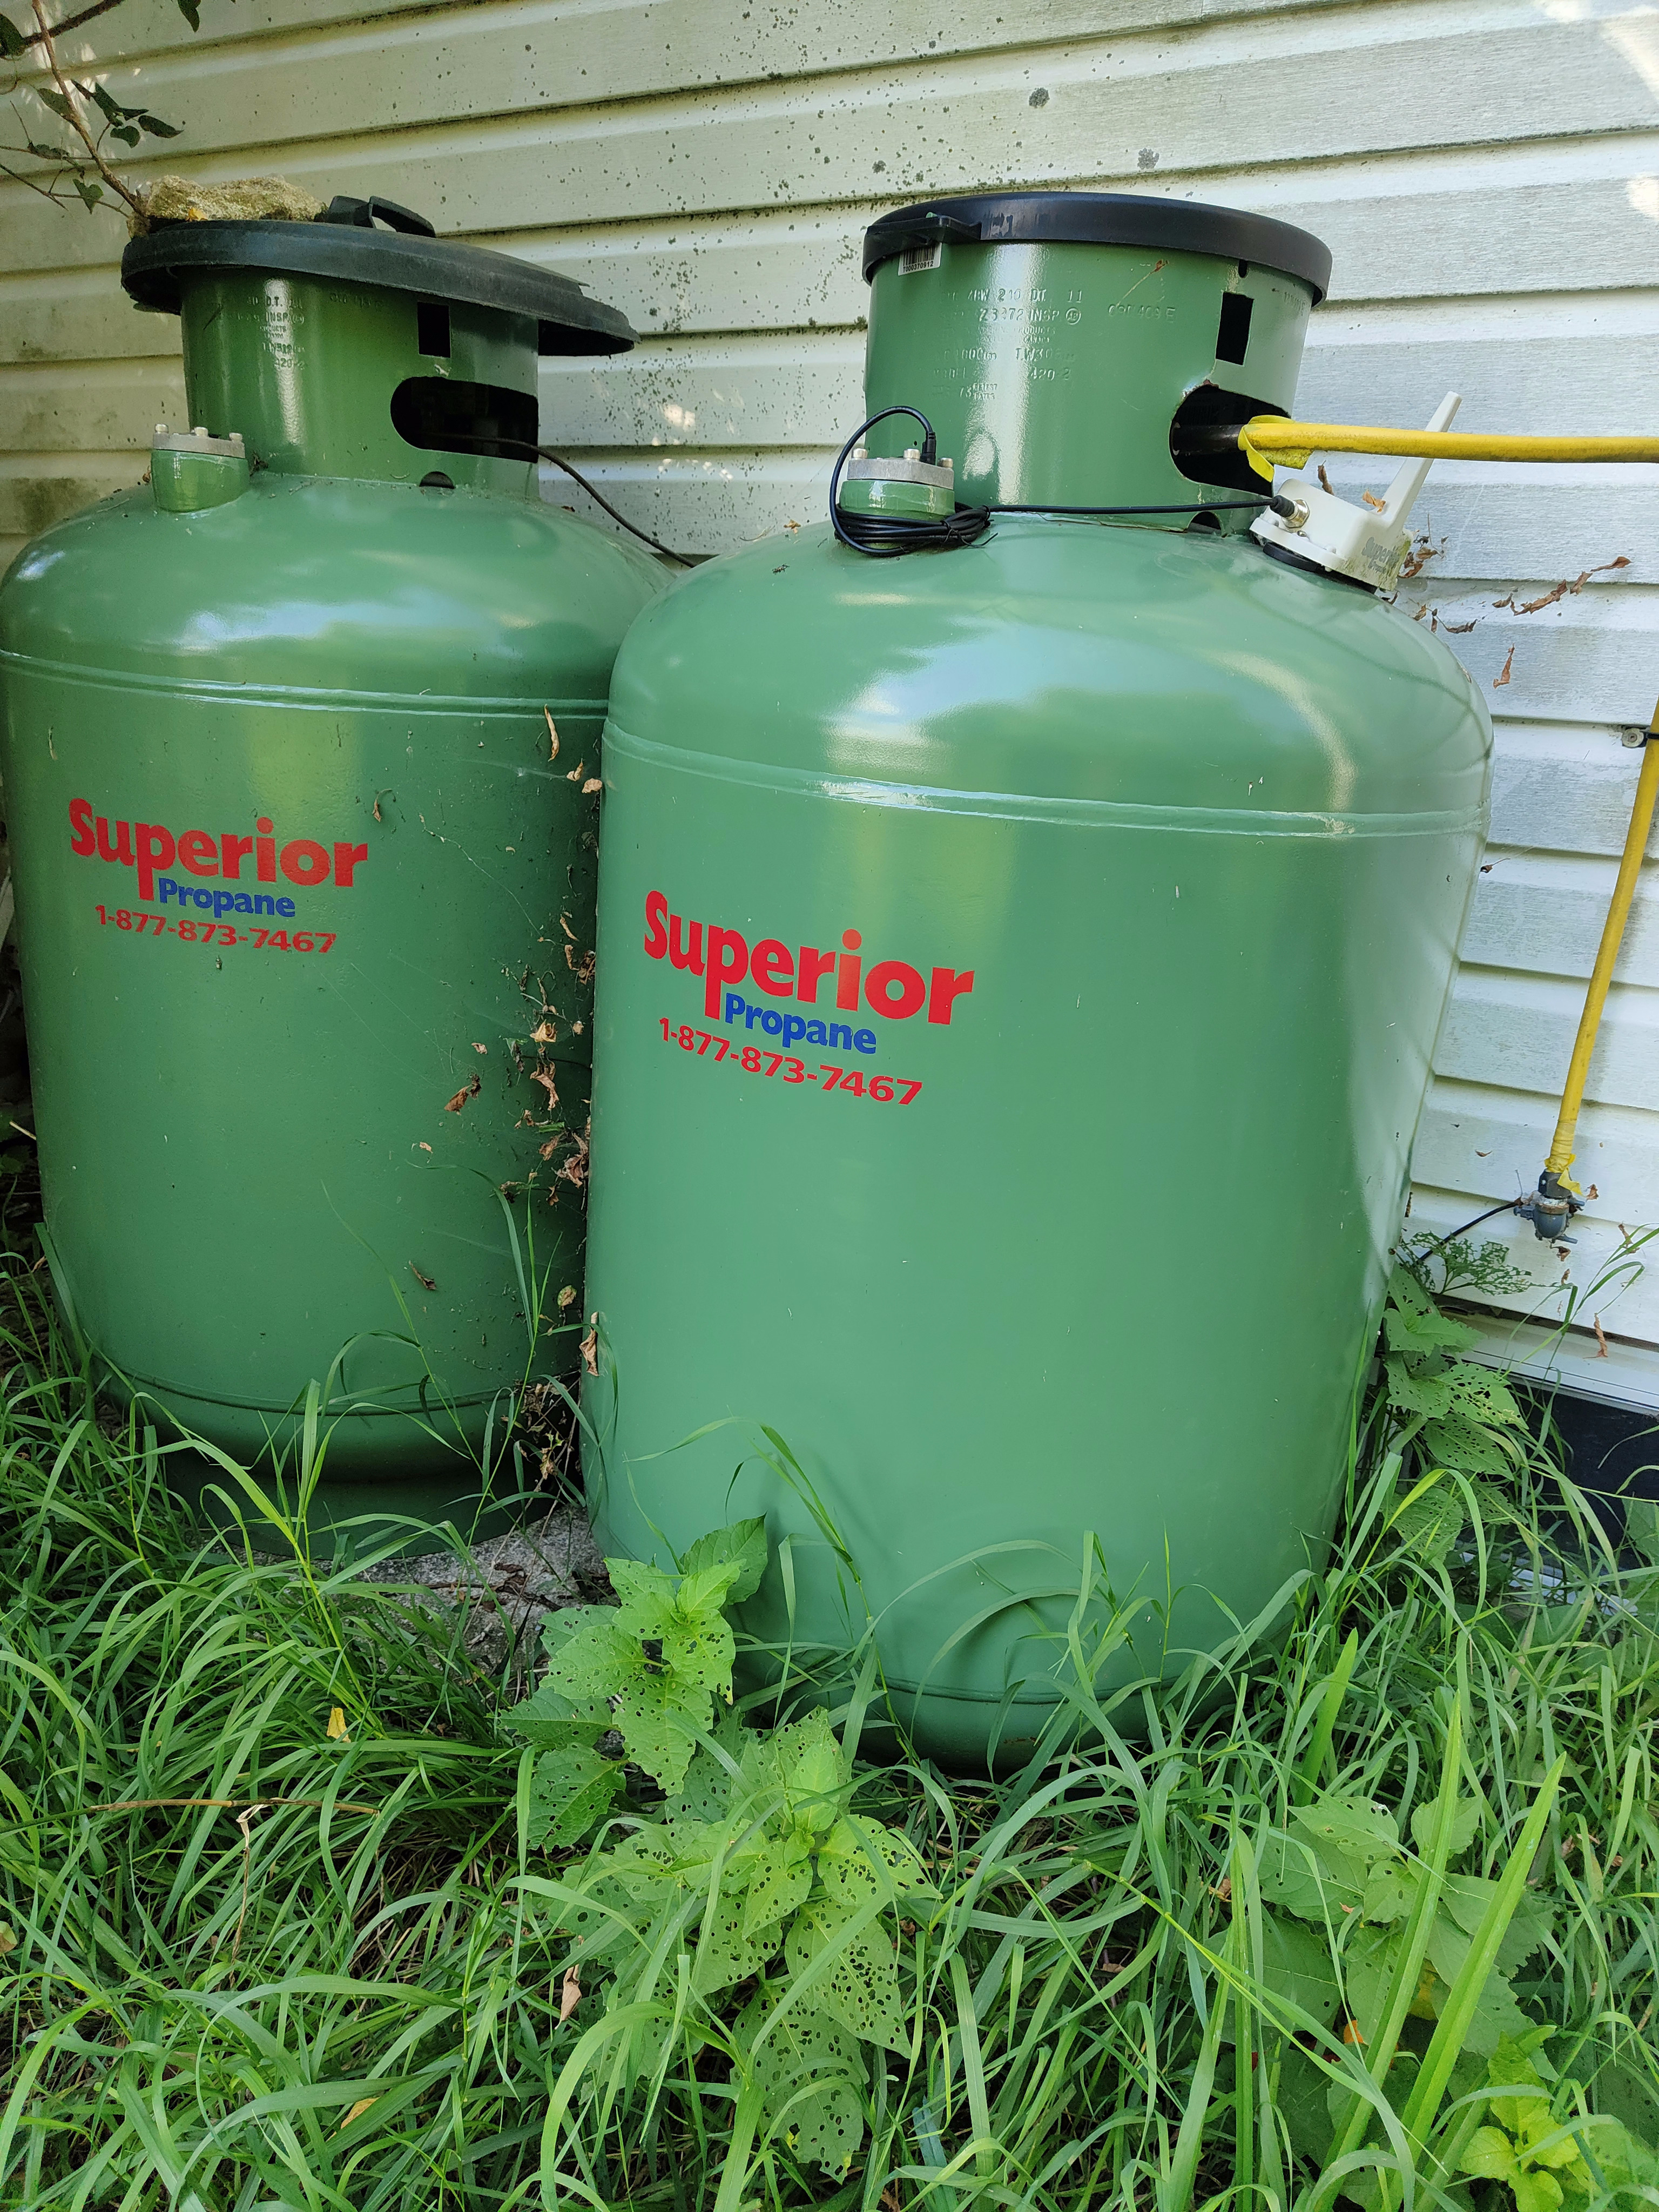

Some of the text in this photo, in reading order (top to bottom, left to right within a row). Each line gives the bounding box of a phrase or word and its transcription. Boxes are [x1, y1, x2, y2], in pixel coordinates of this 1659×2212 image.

[903, 260, 934, 273] T000370912
[69, 798, 368, 901] Superior
[159, 878, 295, 918] Propane
[96, 905, 336, 953] 1-877-873-7467
[644, 891, 975, 1025] Superior
[725, 993, 876, 1054] Propane
[659, 1017, 922, 1105] 1-877-873-7467
